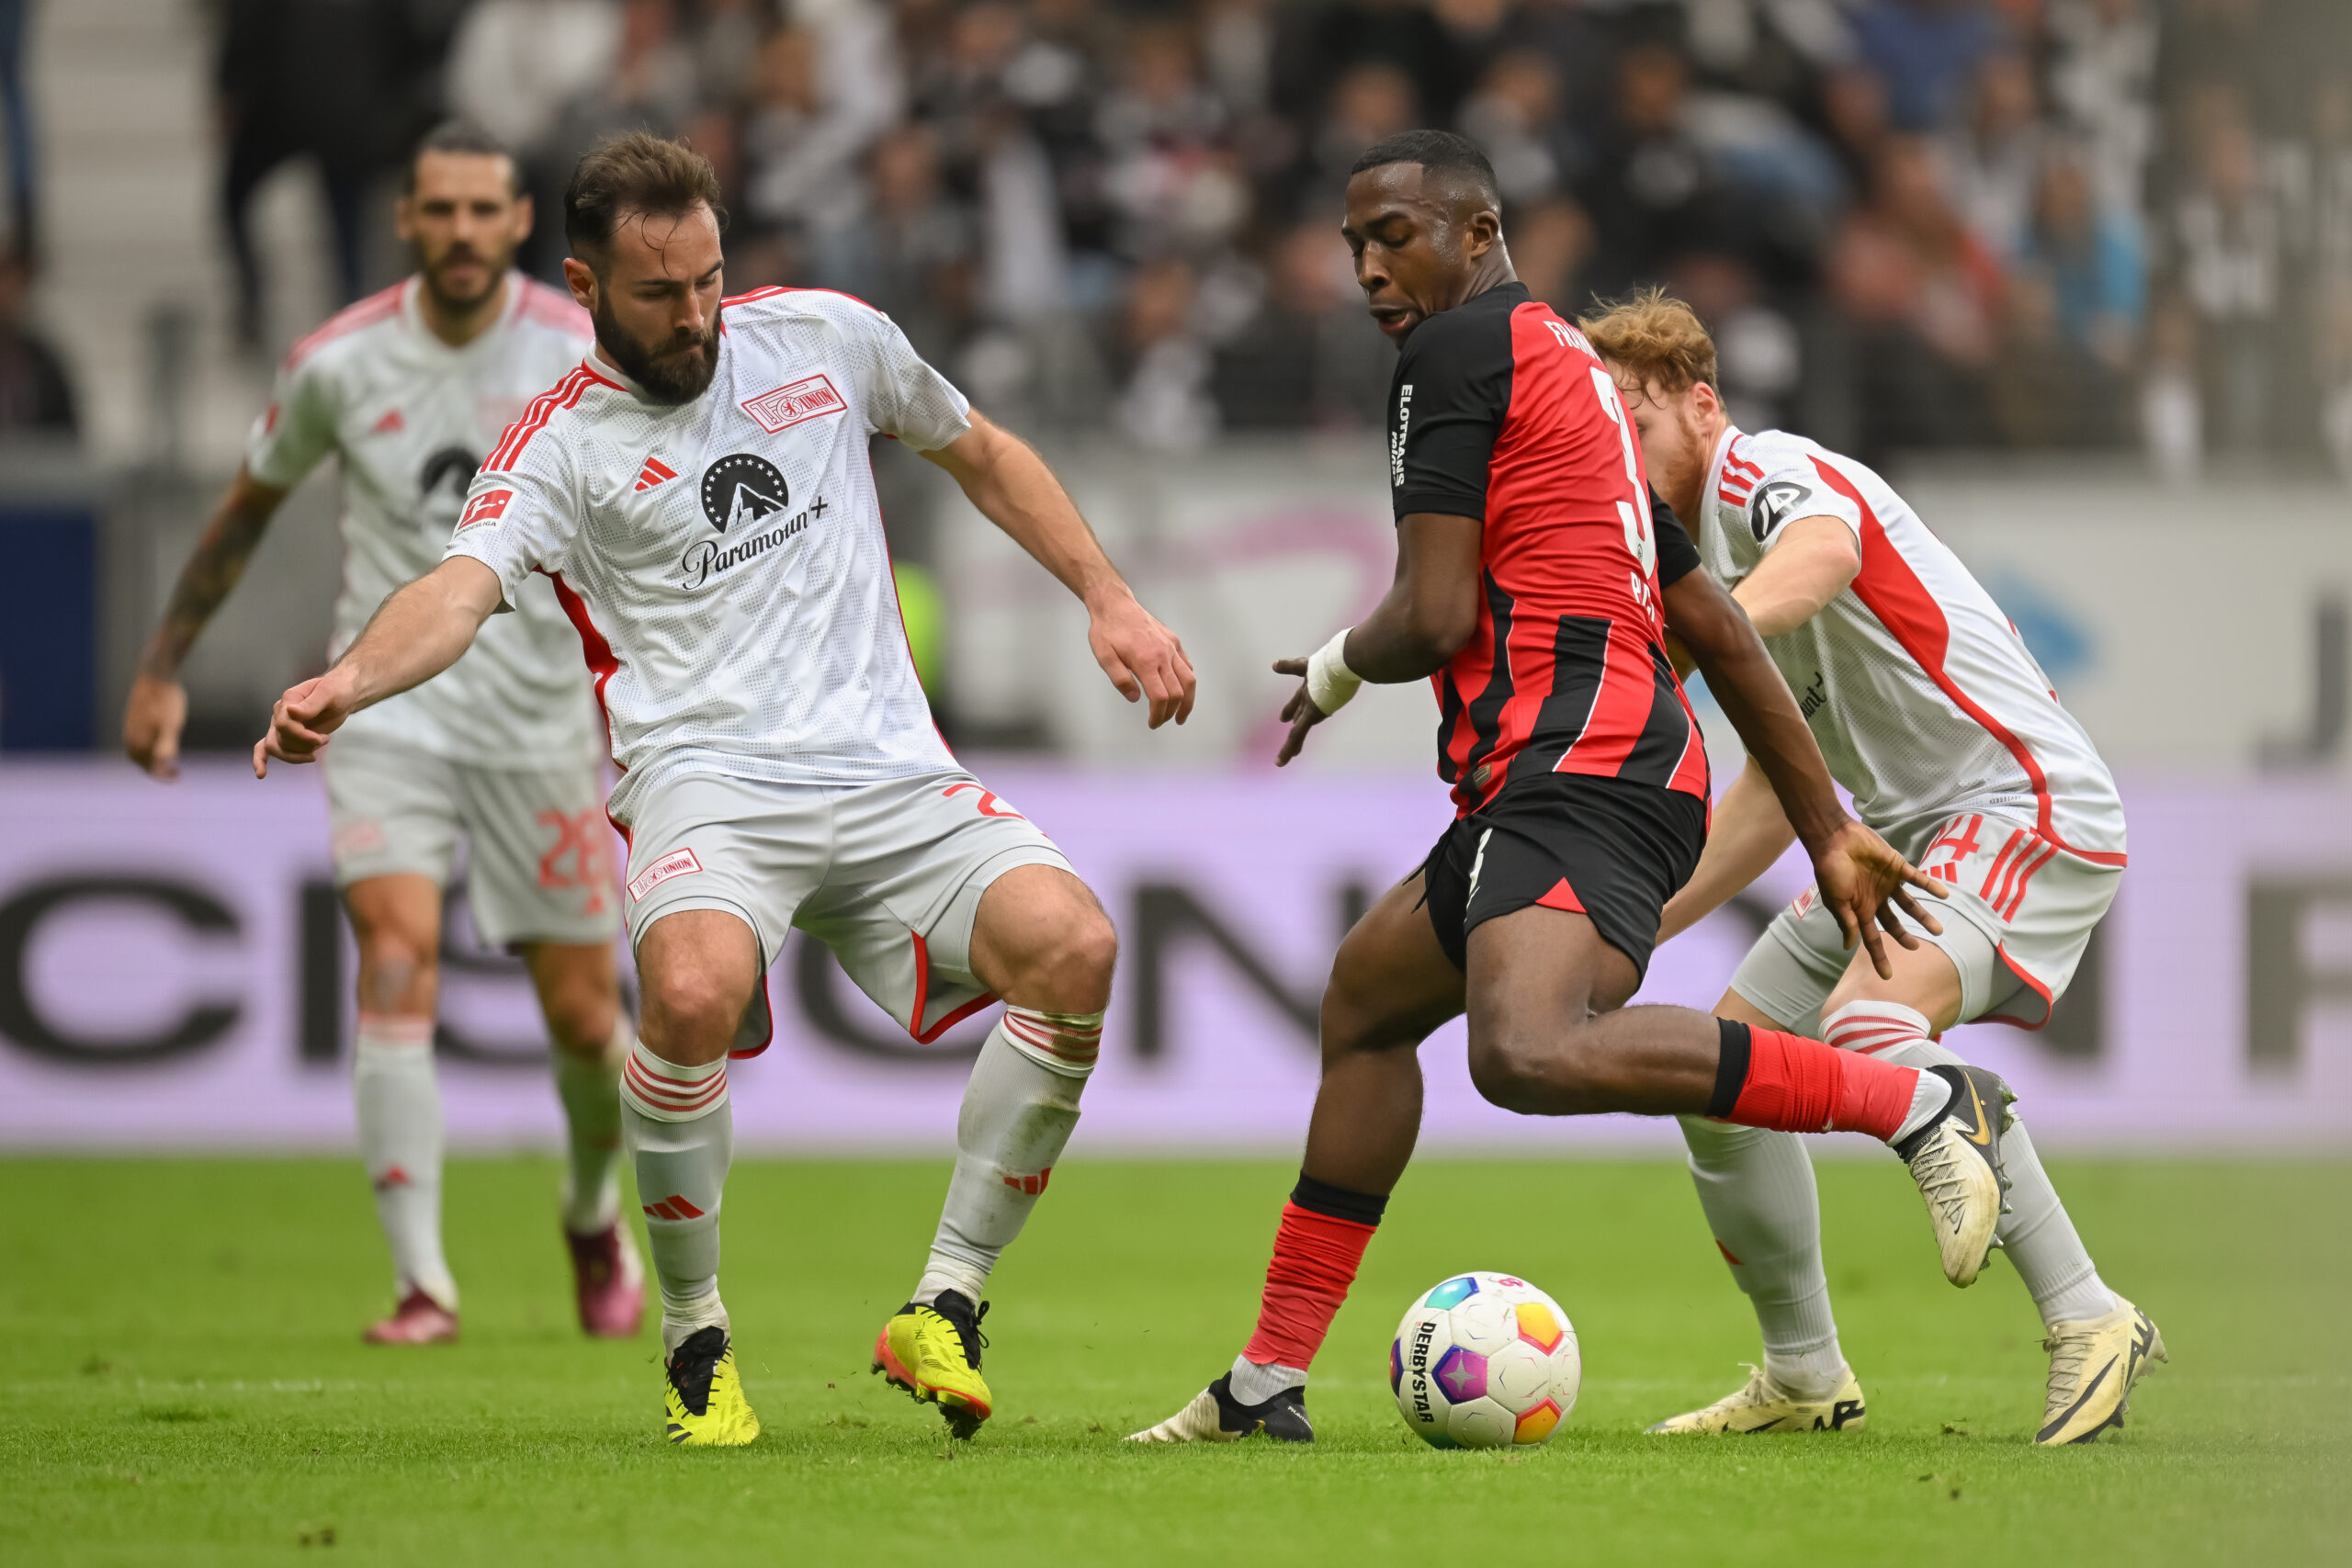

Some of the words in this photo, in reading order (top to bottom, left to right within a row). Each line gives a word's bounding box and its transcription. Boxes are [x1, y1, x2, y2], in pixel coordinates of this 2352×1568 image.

[797, 389, 836, 411] UNION
[1398, 383, 1414, 487] ELOTRANS
[1589, 366, 1657, 581] 3
[682, 495, 829, 591] Paramoun+
[662, 857, 694, 874] UNION
[1412, 1322, 1437, 1424] DERBYSTAR
